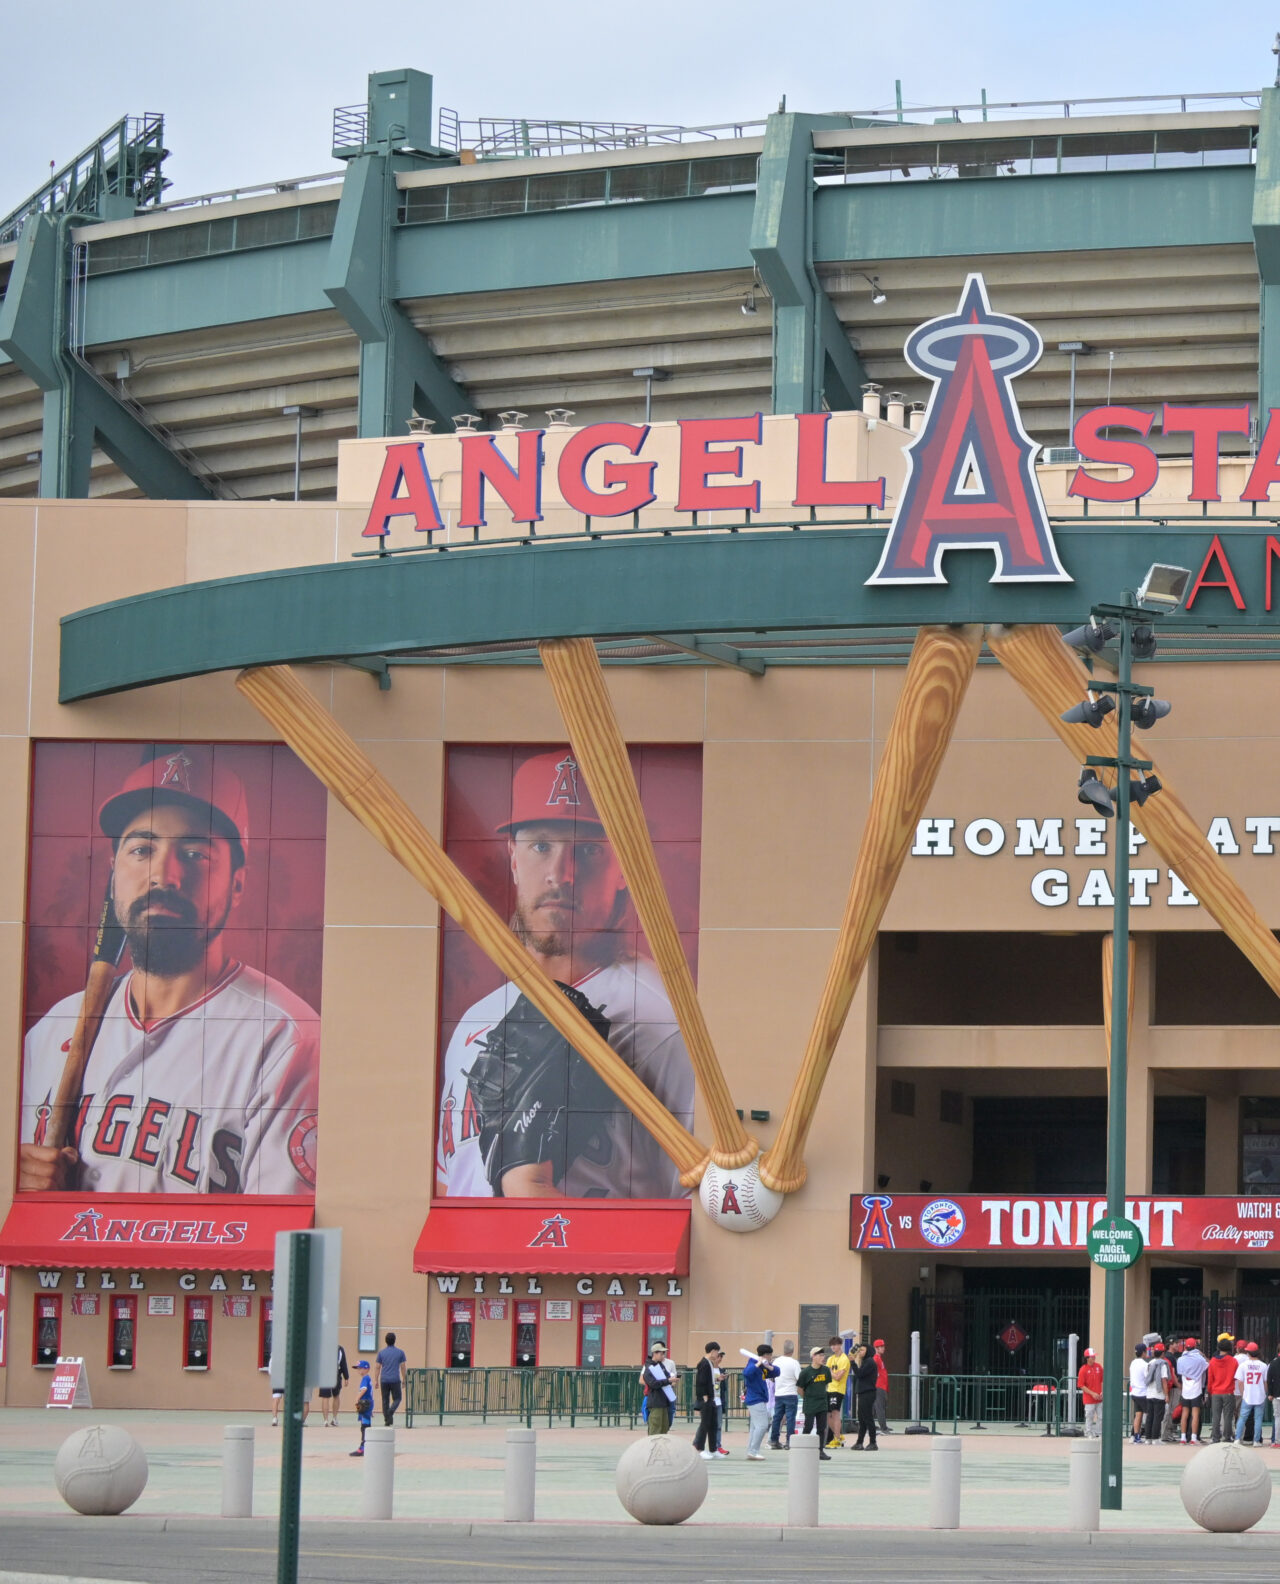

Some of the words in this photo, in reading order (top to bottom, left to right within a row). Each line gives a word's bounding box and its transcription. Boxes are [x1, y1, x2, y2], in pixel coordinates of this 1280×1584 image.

[361, 412, 886, 538] ANGEL
[546, 755, 581, 806] A
[1030, 867, 1200, 907] GATE
[513, 1101, 543, 1135] Thor
[720, 1183, 742, 1213] A
[924, 1202, 953, 1218] TORONTO
[1237, 1202, 1271, 1219] WATCH
[59, 1207, 248, 1244] ANGELS
[526, 1213, 571, 1248] A
[899, 1215, 912, 1229] VS
[923, 1227, 941, 1243] BLUE
[944, 1229, 961, 1243] JAYS
[1092, 1230, 1134, 1239] WELCOME
[1202, 1224, 1243, 1244] Bally
[1243, 1230, 1274, 1240] SPORTS
[1093, 1253, 1131, 1263] STADIUM
[1099, 1244, 1126, 1254] ANGEL
[37, 1271, 146, 1290] WILL
[178, 1273, 275, 1292] CAL
[436, 1276, 542, 1294] WILL
[576, 1278, 682, 1296] CALL
[650, 1315, 666, 1325] VIP
[1246, 1372, 1262, 1384] 27
